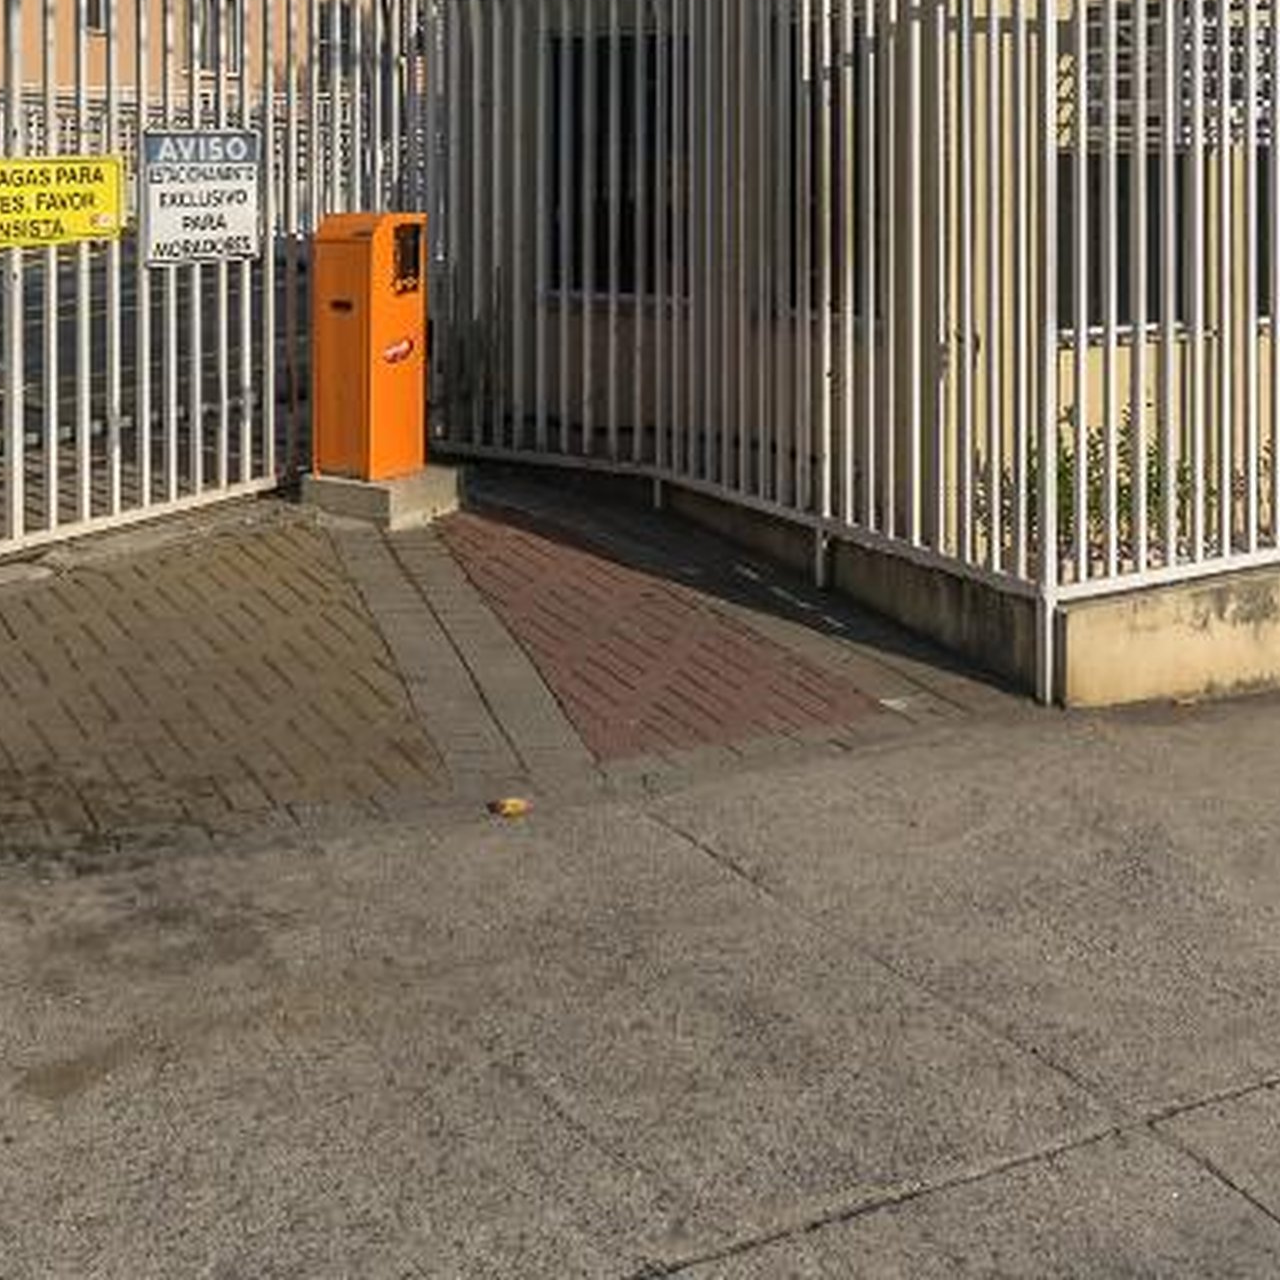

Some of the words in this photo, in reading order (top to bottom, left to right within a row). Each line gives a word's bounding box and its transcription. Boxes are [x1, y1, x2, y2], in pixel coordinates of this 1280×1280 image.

[159, 136, 248, 161] AVISO
[56, 166, 104, 185] PARA
[36, 193, 95, 211] FAVOR
[182, 213, 227, 231] PARA
